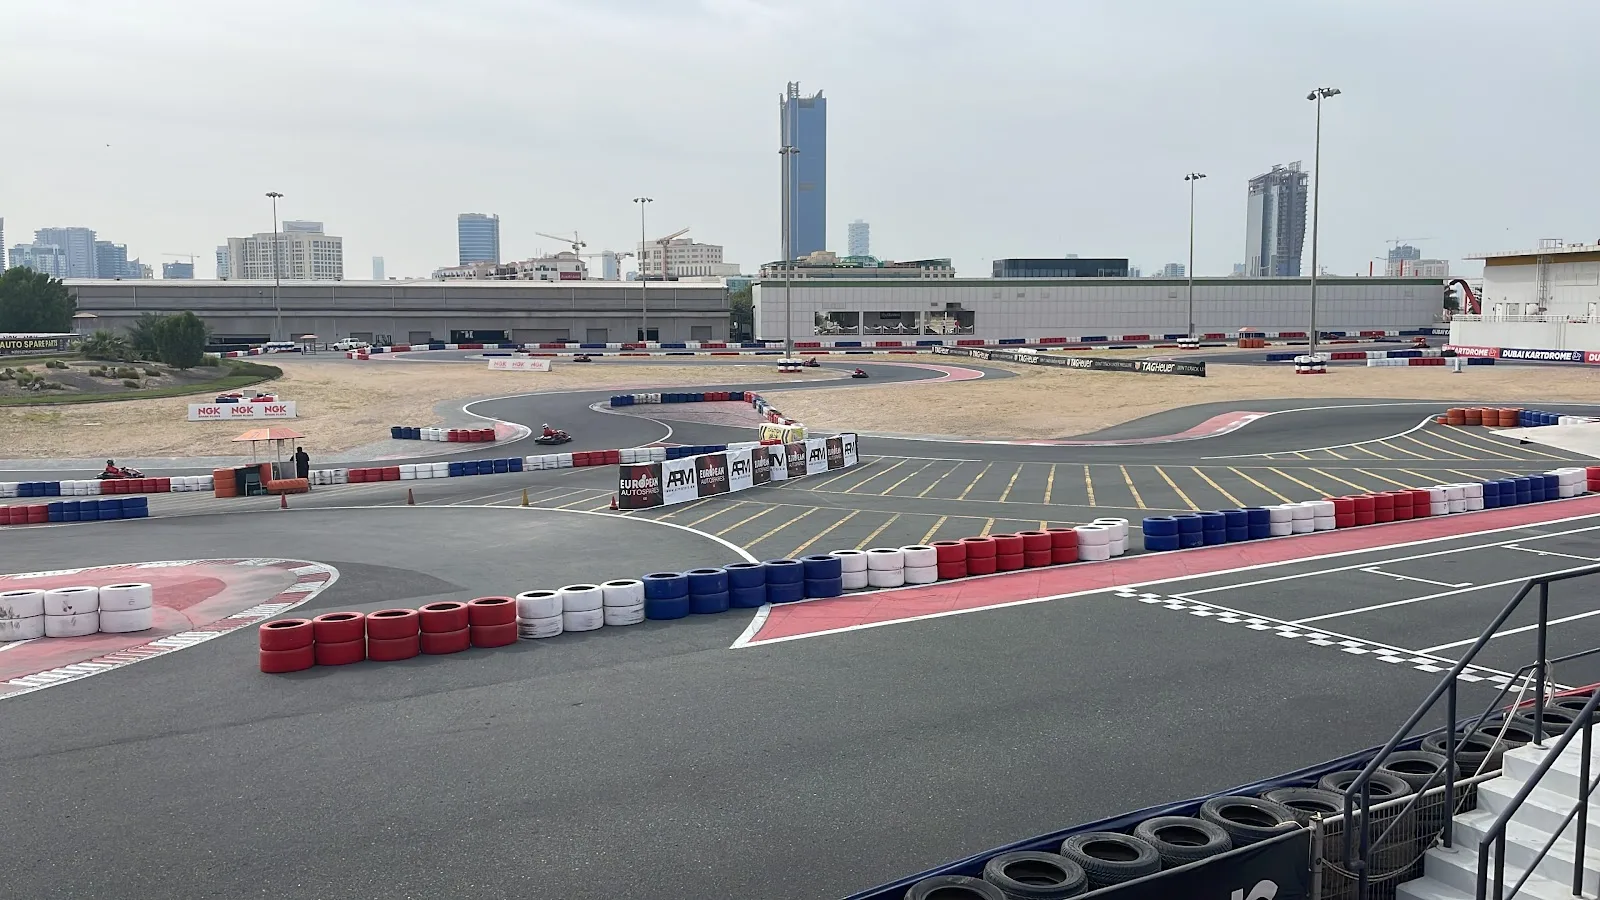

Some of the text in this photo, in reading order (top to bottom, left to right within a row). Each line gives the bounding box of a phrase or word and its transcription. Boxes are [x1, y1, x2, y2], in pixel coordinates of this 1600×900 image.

[0, 339, 58, 349] AUTO SPARE PARTS
[1502, 349, 1572, 360] DUBAI KARTDROME
[198, 406, 220, 415] NGK
[264, 405, 286, 413] NGK
[845, 442, 854, 454] ARM
[810, 447, 825, 462] ARM
[700, 464, 724, 478] EUROPEAN
[732, 458, 750, 476] ARM
[620, 474, 658, 488] EUROPEAN
[667, 468, 694, 488] ARM
[620, 487, 660, 496] AUTOSPARES
